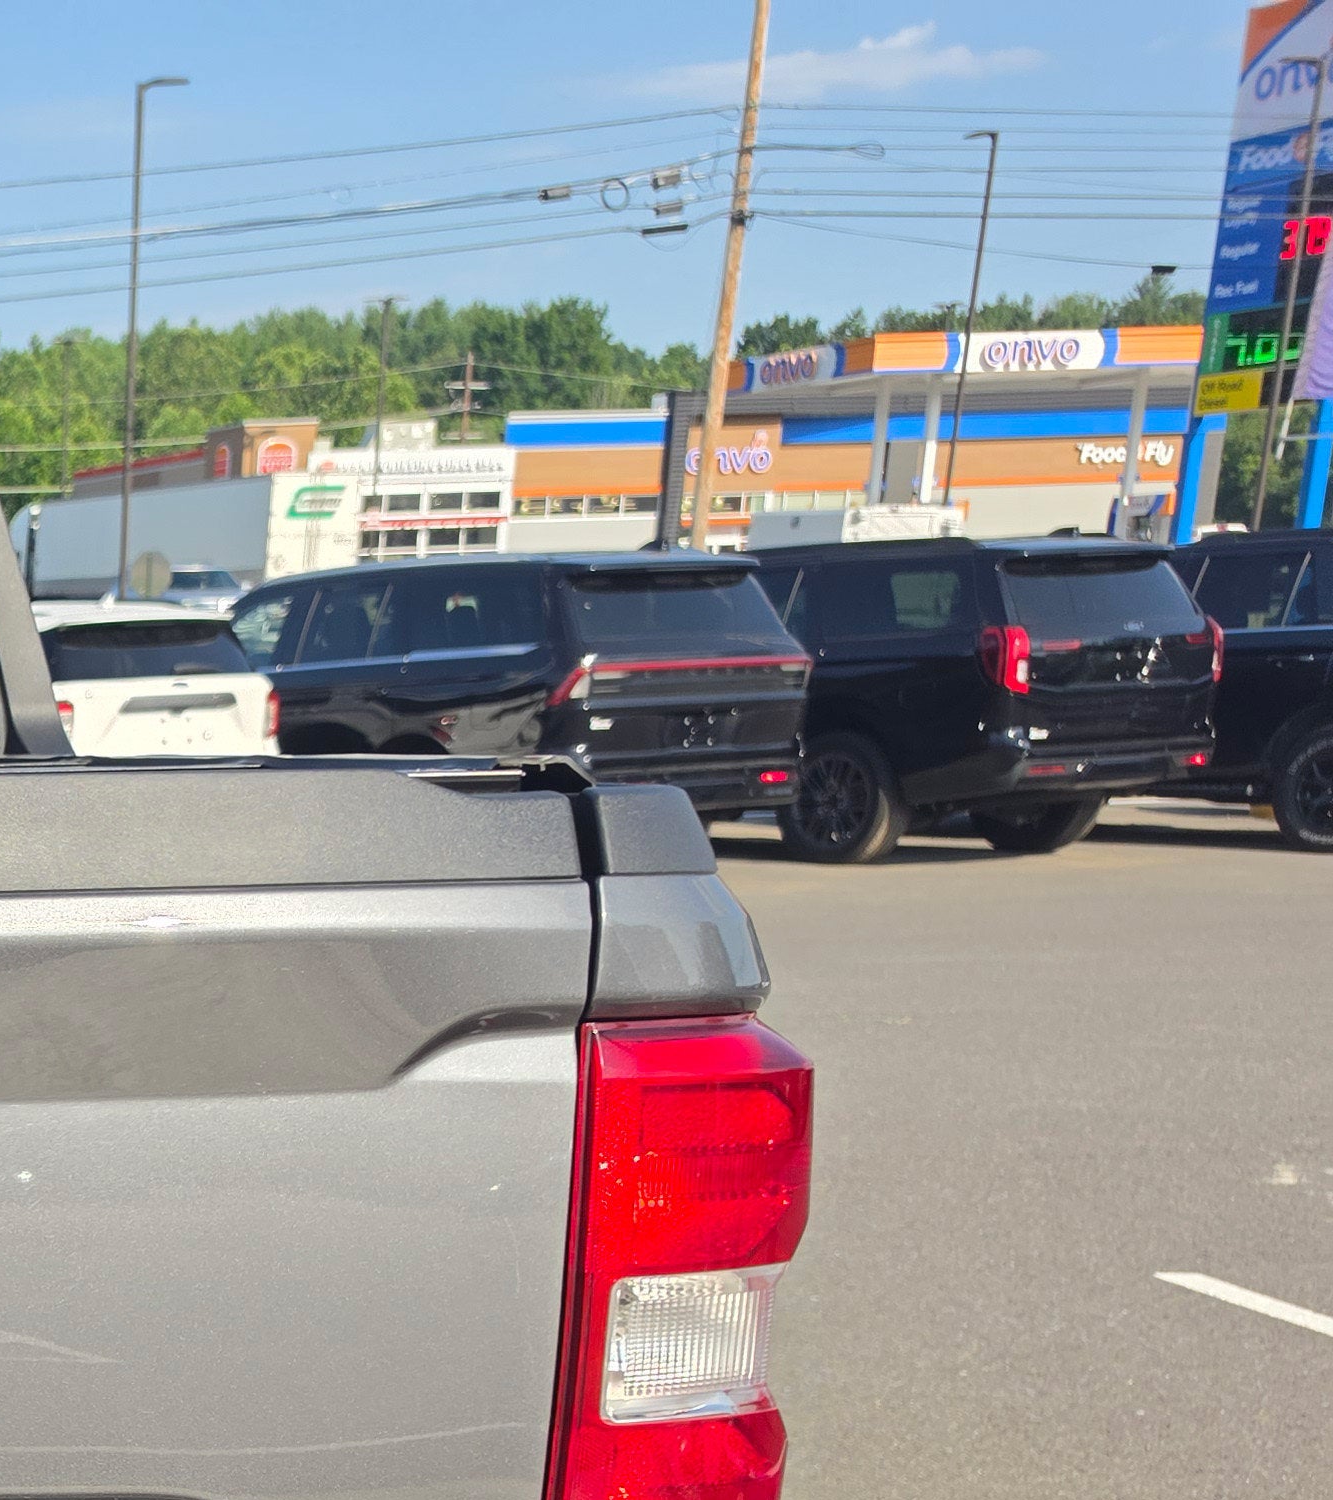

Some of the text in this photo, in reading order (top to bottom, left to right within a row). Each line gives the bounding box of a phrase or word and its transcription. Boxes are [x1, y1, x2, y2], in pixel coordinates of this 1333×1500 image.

[1255, 54, 1333, 101] onv
[985, 339, 1080, 365] onvo
[760, 355, 813, 385] onvo
